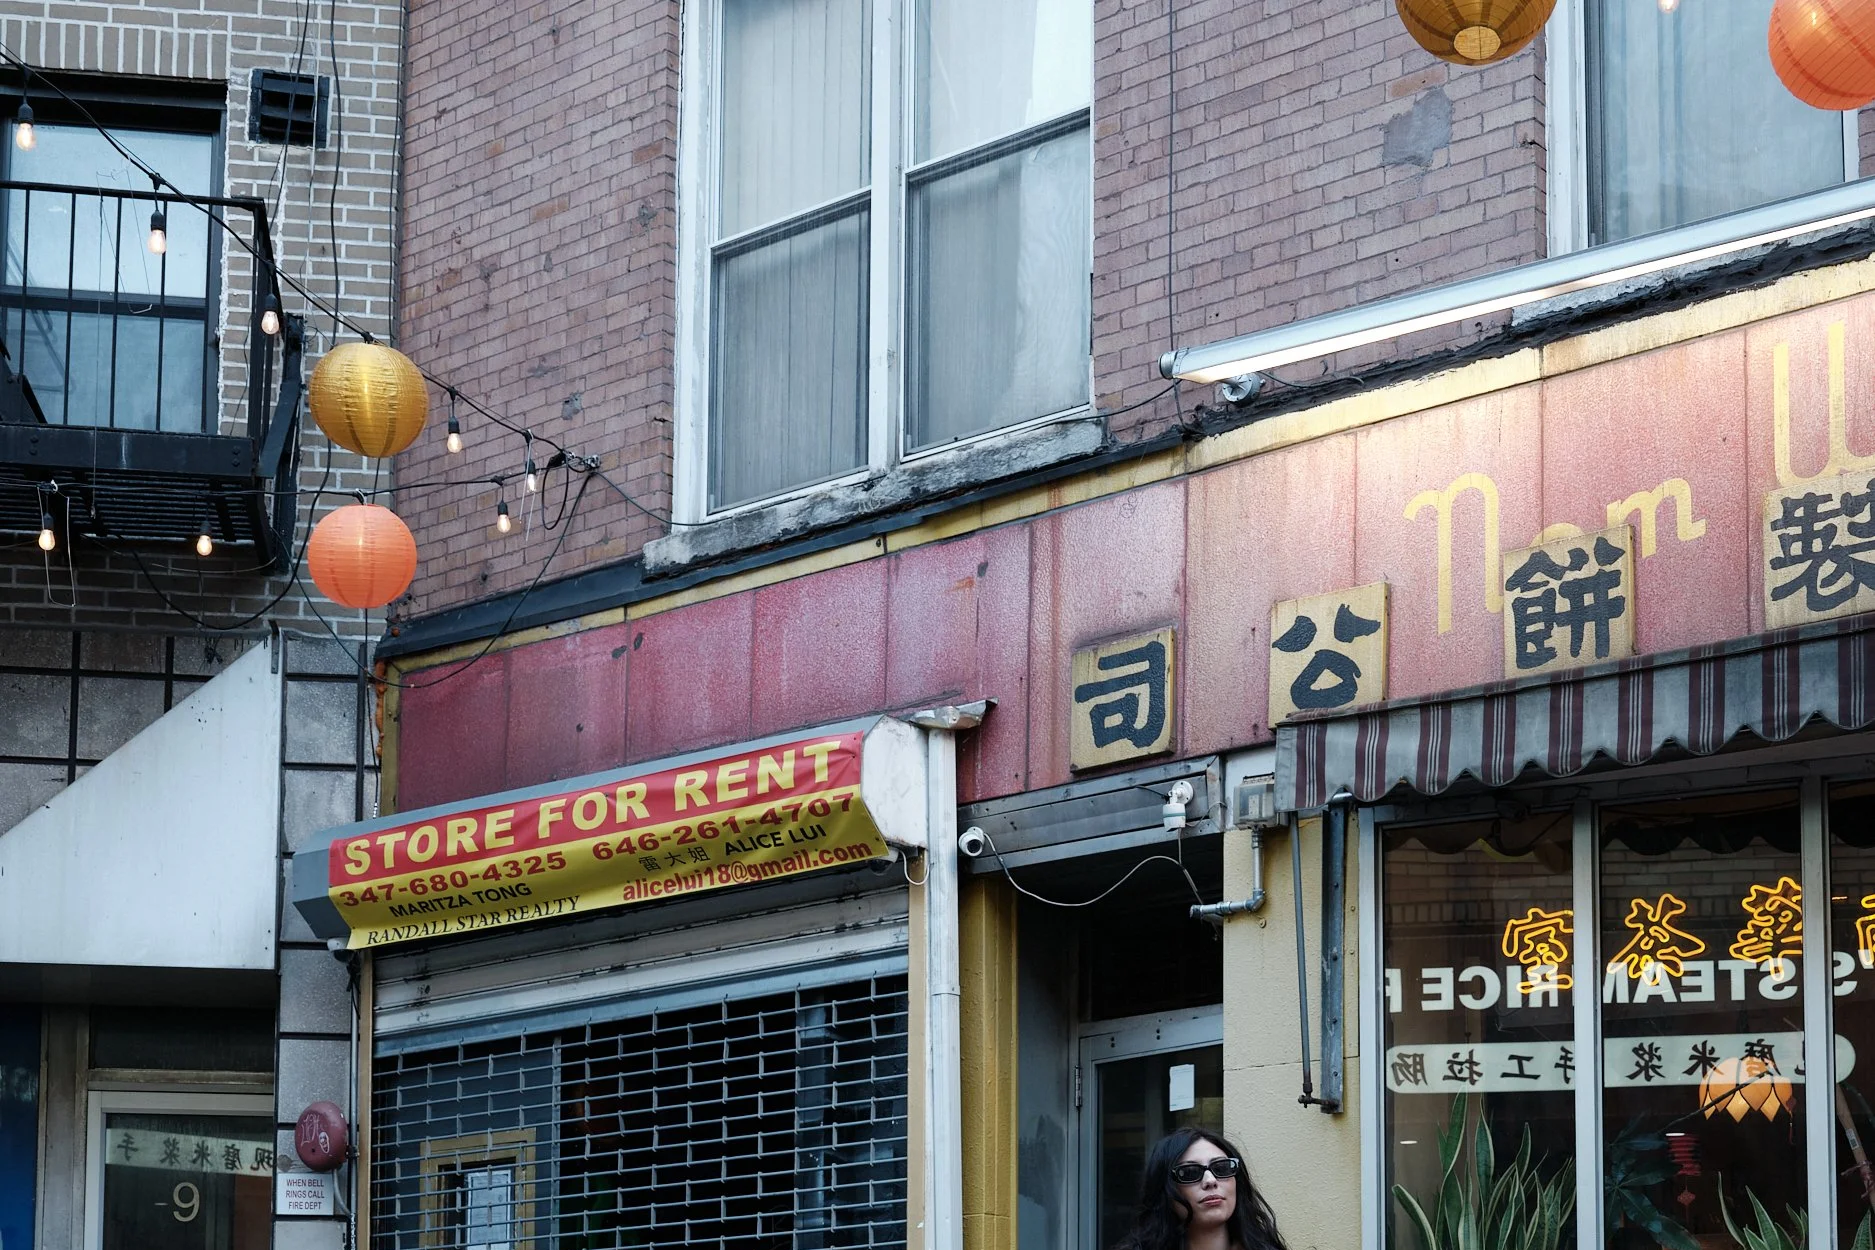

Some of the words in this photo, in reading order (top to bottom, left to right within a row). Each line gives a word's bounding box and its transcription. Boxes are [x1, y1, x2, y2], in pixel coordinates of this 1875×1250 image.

[344, 808, 515, 876] STORE
[538, 782, 651, 840] FOR
[674, 740, 842, 812] RENT
[339, 851, 567, 907] 347-680-4325
[592, 792, 856, 860] 646-261-4707
[724, 829, 782, 856] ALICE
[788, 824, 827, 844] LUI
[623, 841, 873, 901] alicelui18@gmail.com
[638, 847, 710, 873] 雷大姐
[389, 895, 471, 918] MARITZA
[472, 882, 533, 905] TONG
[367, 918, 453, 945] RANDALL
[456, 907, 505, 932] STAR
[507, 895, 580, 921] REALTY
[285, 1190, 306, 1199] RINGS
[307, 1190, 325, 1199] CALL
[286, 1178, 306, 1188] WHEN
[307, 1178, 325, 1188] BELL
[172, 1182, 200, 1223] 9
[288, 1201, 304, 1210] FIRE
[304, 1201, 322, 1210] DEPT
